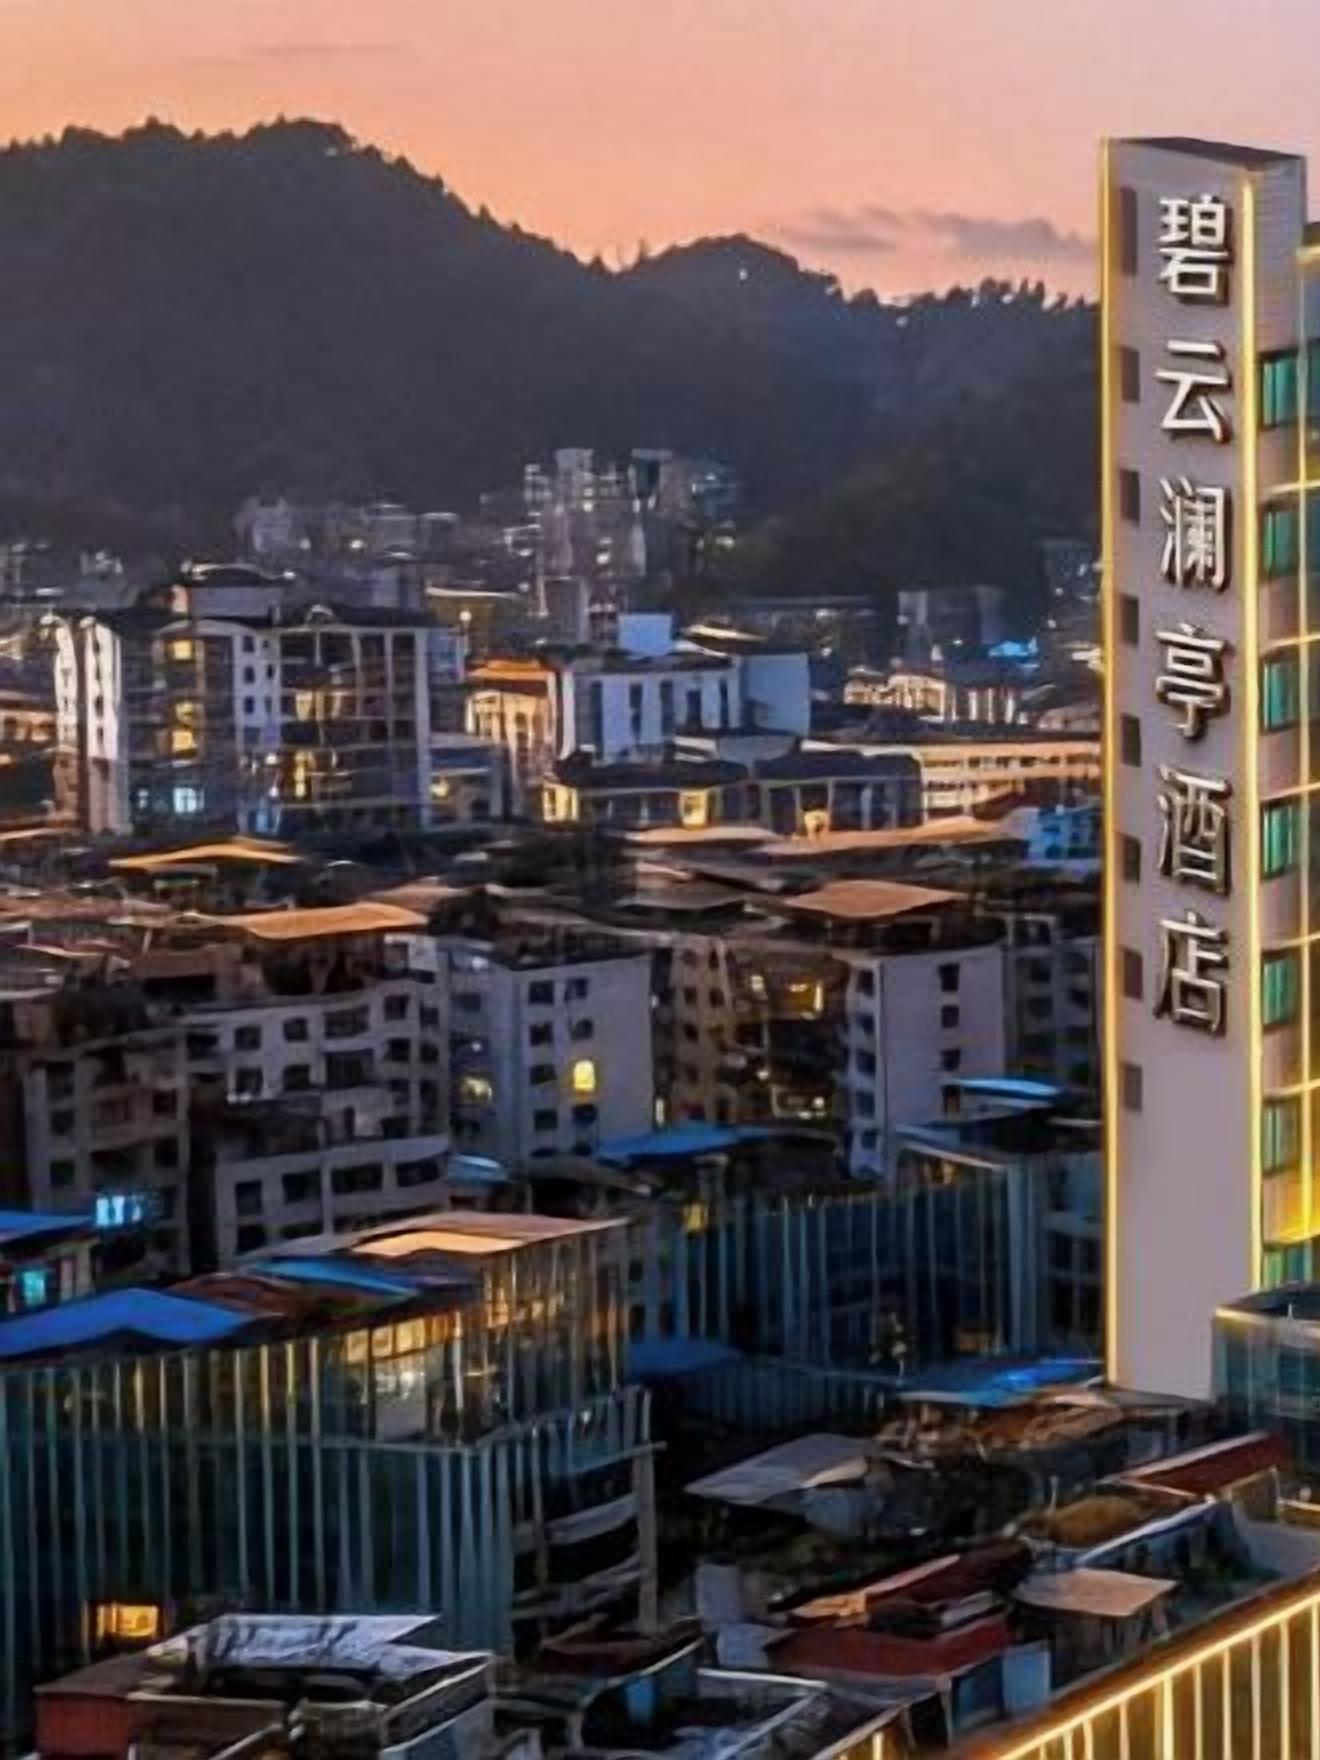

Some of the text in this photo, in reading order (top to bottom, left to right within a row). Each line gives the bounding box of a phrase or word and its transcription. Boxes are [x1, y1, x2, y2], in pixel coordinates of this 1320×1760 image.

[1155, 193, 1230, 1034] 碧云澜亭酒店
